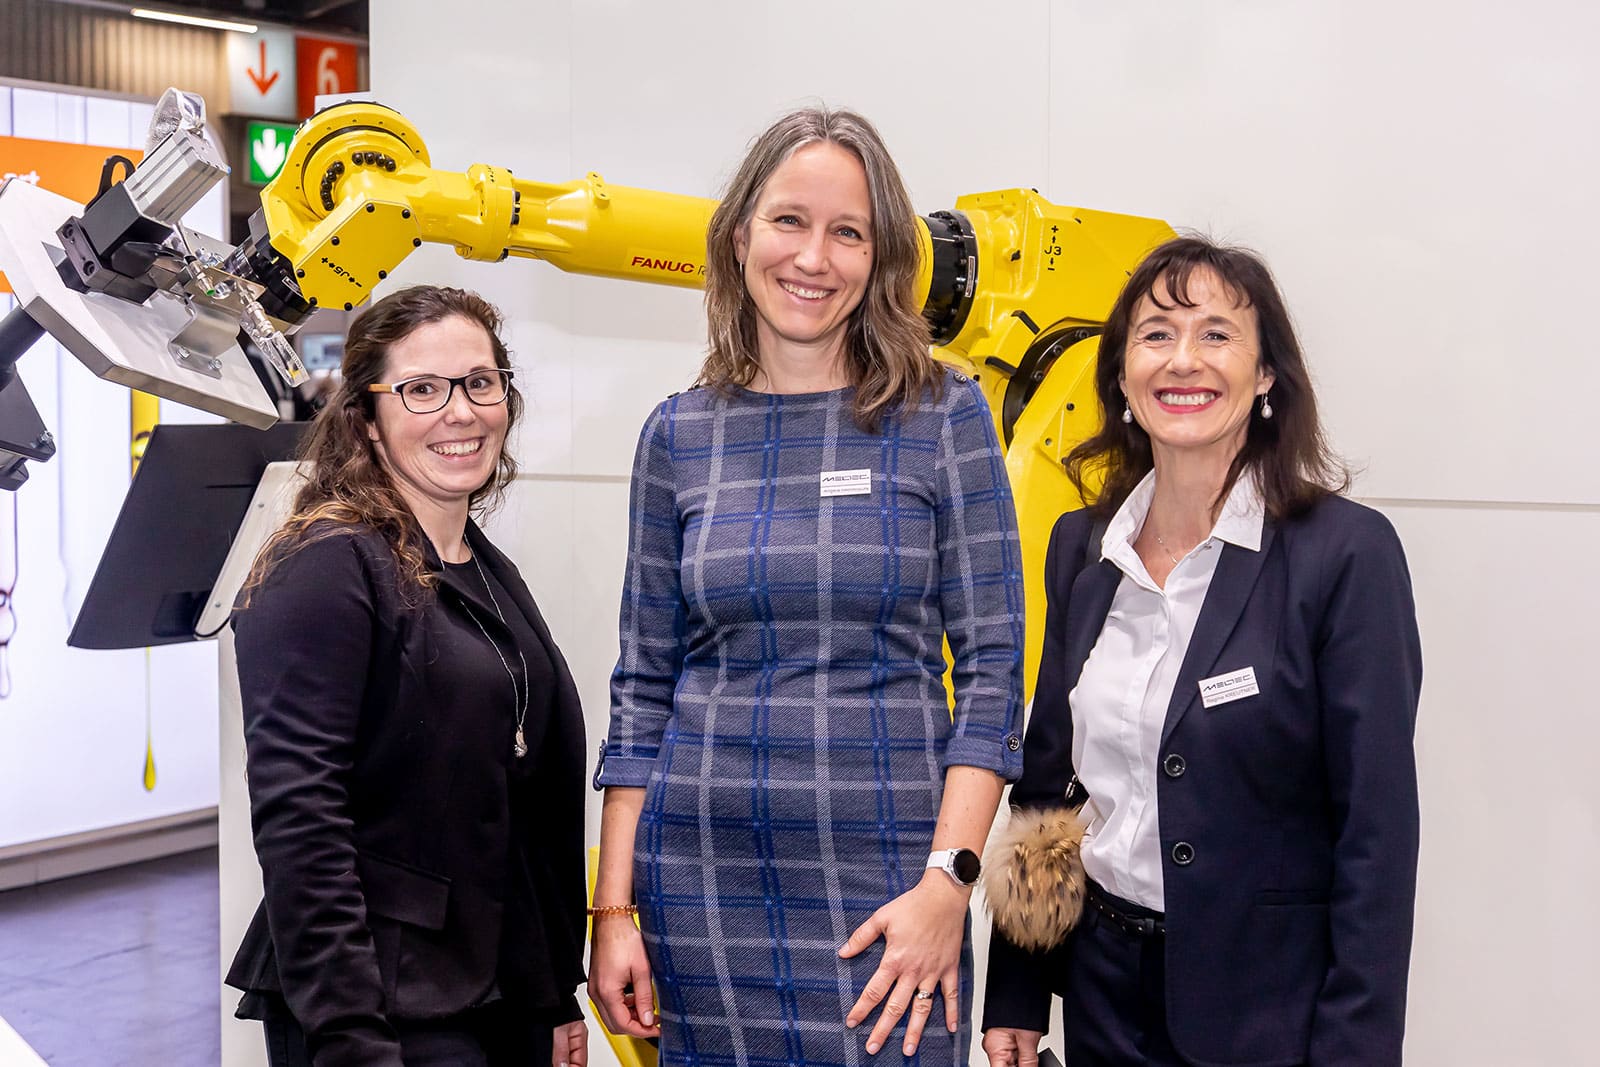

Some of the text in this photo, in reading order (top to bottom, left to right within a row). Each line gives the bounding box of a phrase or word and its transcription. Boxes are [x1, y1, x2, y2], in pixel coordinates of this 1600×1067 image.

[317, 47, 340, 94] 6
[1044, 245, 1062, 256] J3
[631, 256, 695, 274] FANUC
